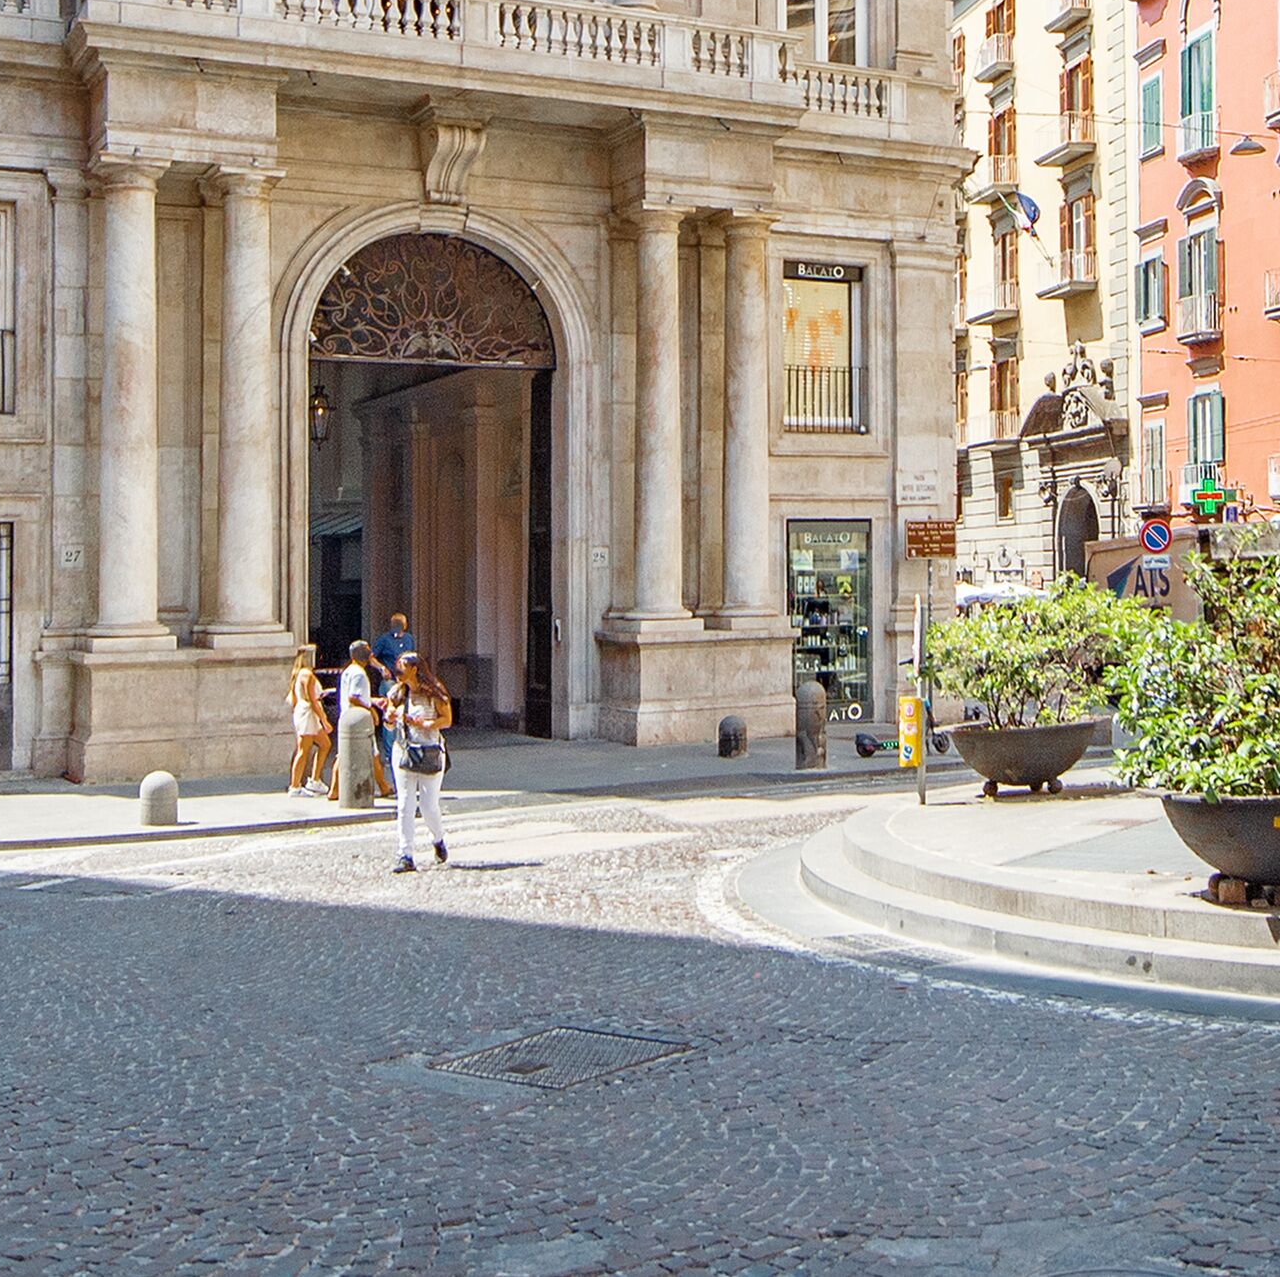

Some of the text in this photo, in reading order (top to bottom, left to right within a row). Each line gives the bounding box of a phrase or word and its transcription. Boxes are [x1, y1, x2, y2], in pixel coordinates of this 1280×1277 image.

[798, 263, 842, 278] BALATO
[804, 531, 850, 543] BALATO
[65, 550, 81, 562] 27
